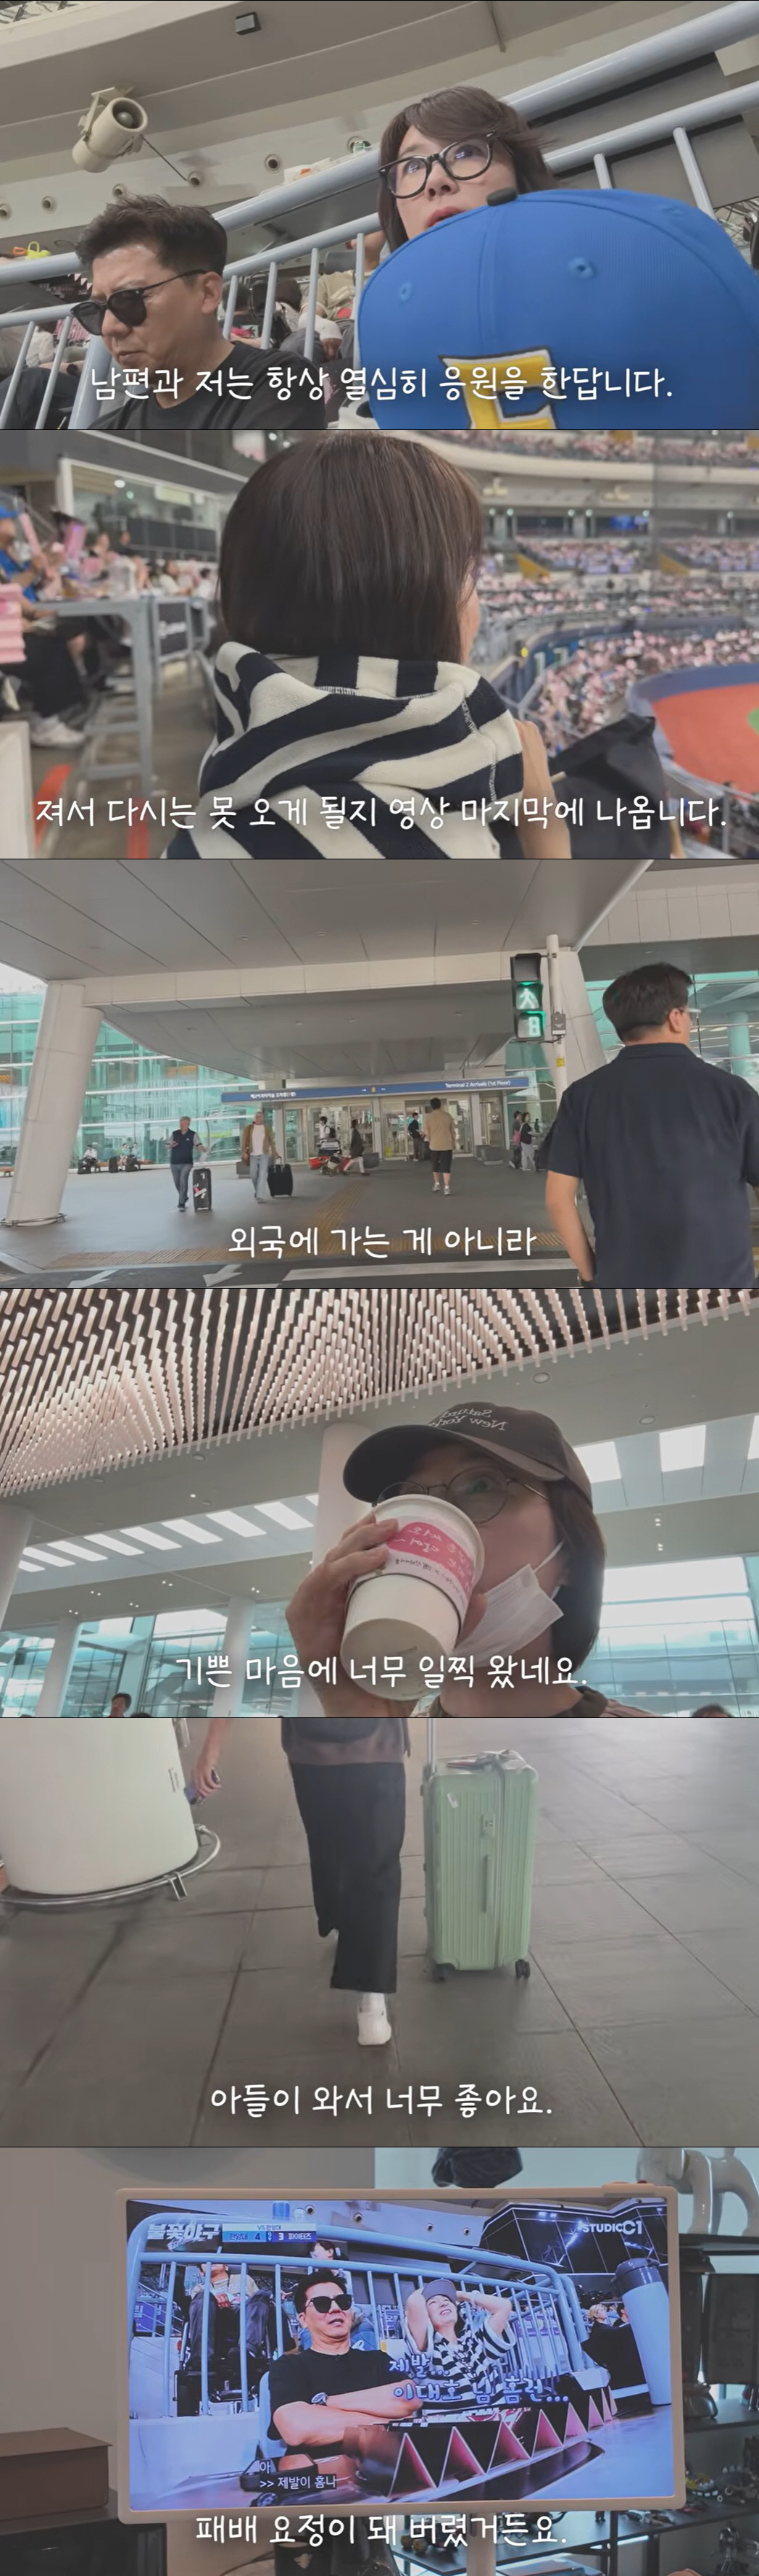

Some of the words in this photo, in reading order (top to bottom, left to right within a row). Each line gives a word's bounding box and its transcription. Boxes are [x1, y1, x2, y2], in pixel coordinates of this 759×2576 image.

[278, 2232, 283, 2241] 3
[394, 2379, 463, 2401] 이대호
[471, 2379, 492, 2405] 님
[260, 2461, 271, 2474] 아
[278, 2475, 311, 2489] 제발이
[315, 2475, 336, 2488] 홈나
